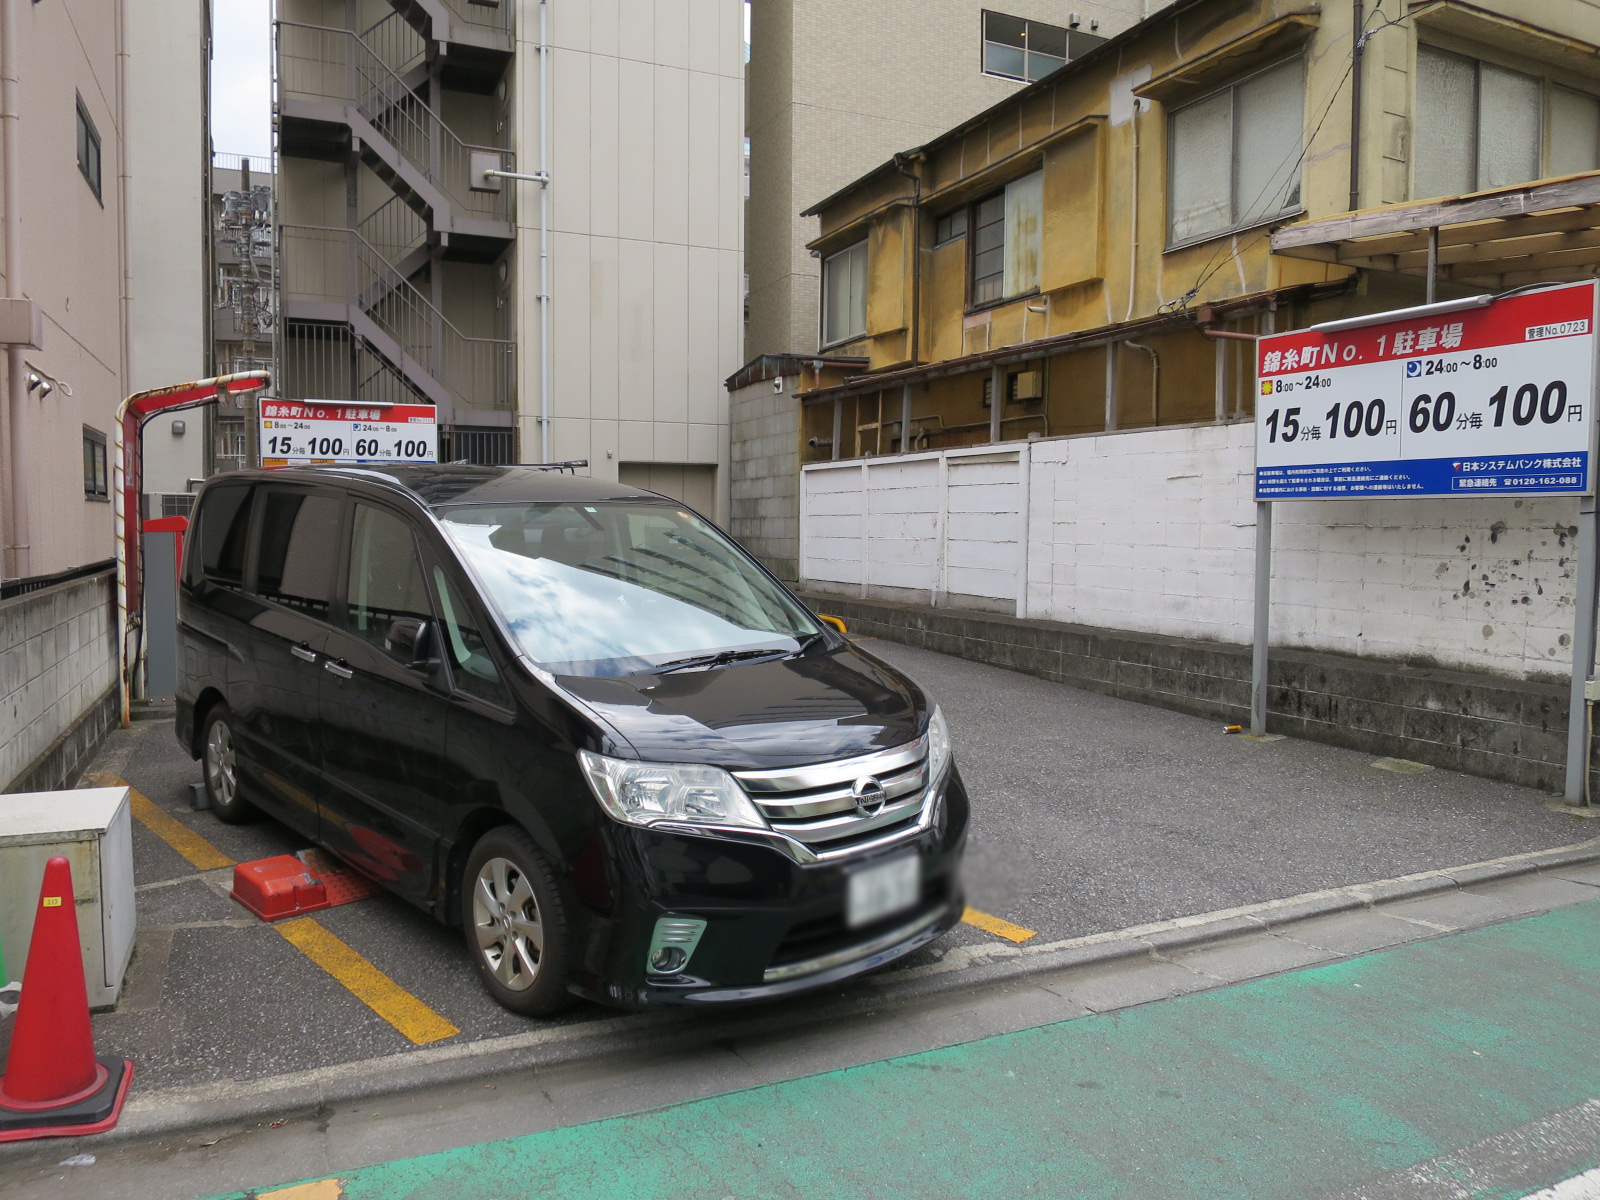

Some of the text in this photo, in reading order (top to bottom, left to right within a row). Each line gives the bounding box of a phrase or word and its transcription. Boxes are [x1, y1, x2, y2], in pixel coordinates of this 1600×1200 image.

[1527, 320, 1585, 339] 管理No.0723
[1462, 457, 1582, 472] 日本システムバンク株式会社
[1512, 476, 1577, 486] 0120-162-088
